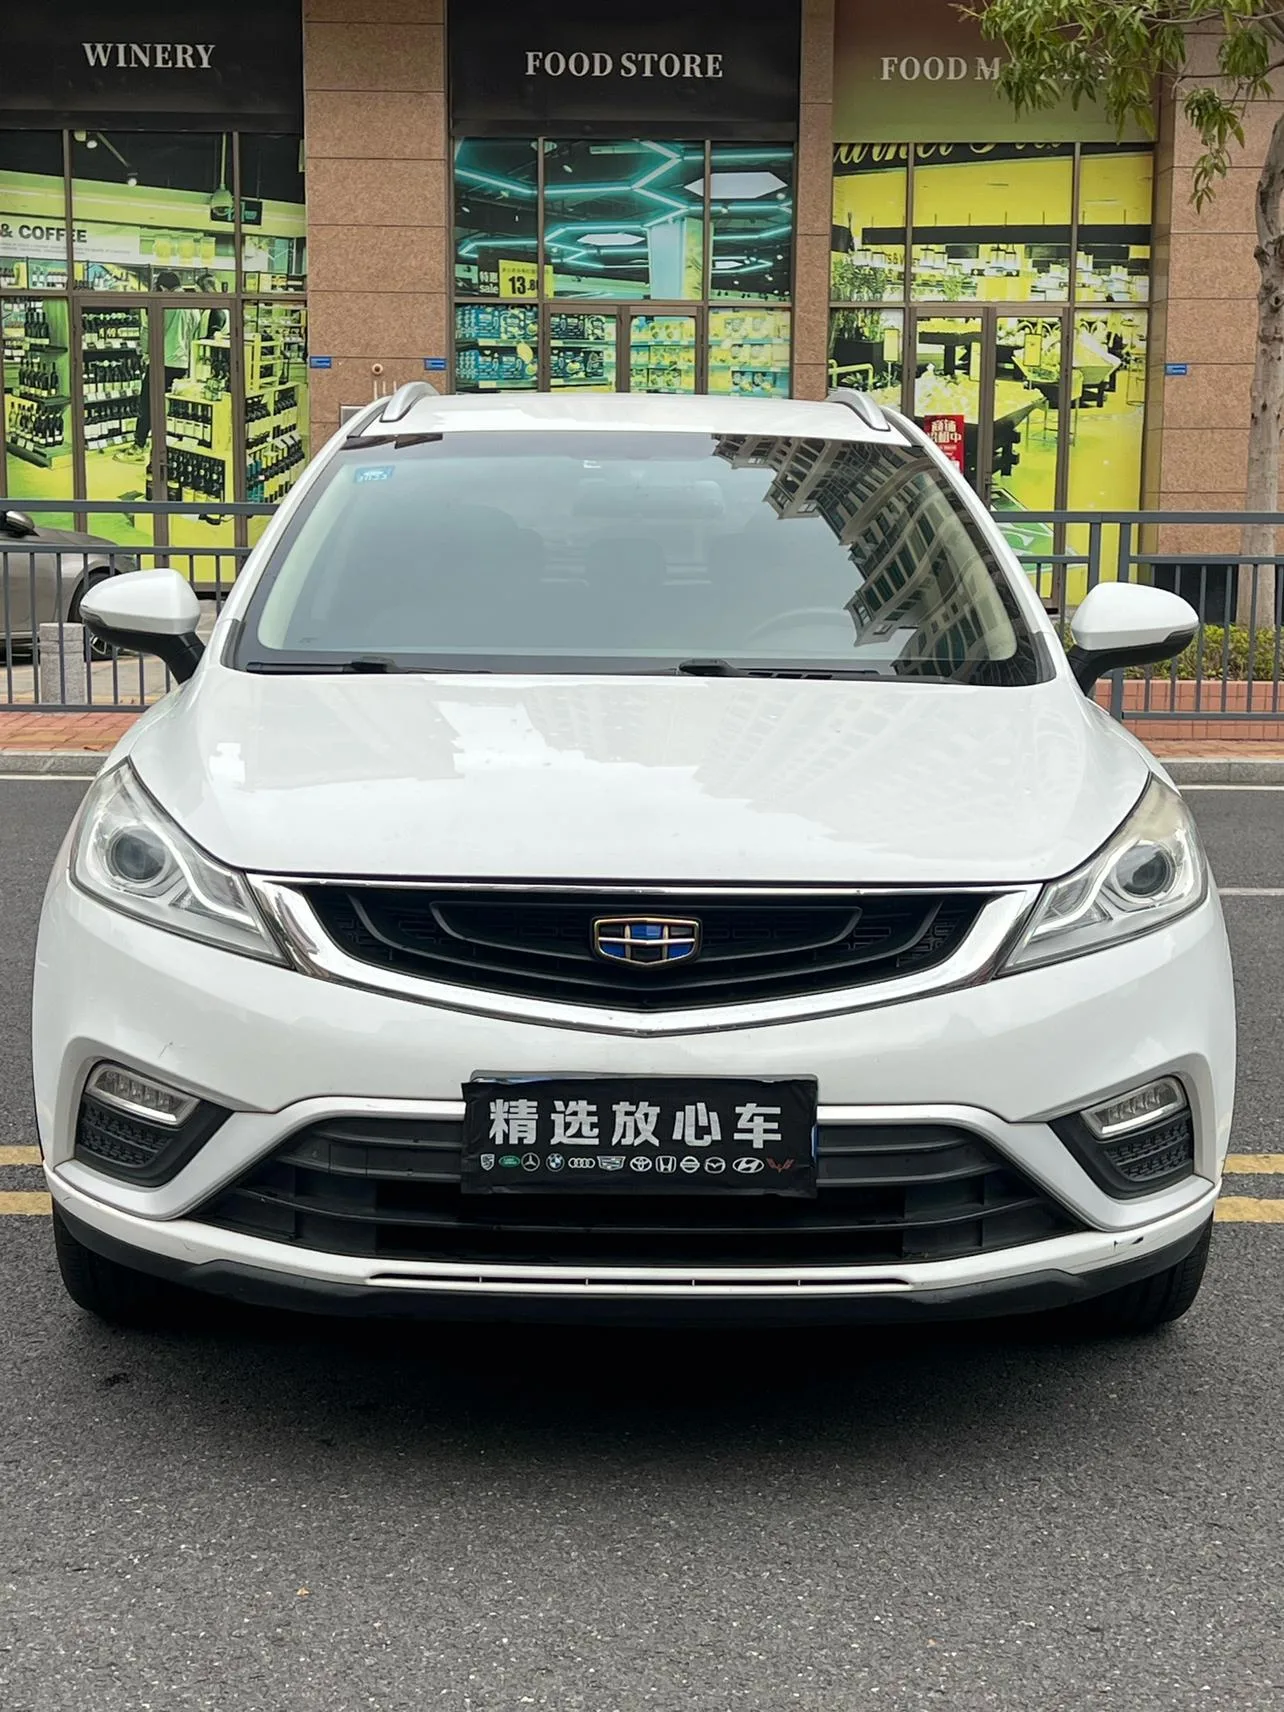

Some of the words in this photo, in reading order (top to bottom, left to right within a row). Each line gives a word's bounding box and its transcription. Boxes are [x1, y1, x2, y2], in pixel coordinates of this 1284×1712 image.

[82, 42, 216, 69] WINERY
[525, 51, 613, 77] FOOD
[620, 52, 723, 78] STORE
[880, 56, 968, 81] FOOD
[480, 283, 499, 294] sale
[489, 1099, 782, 1149] 精选放心车
